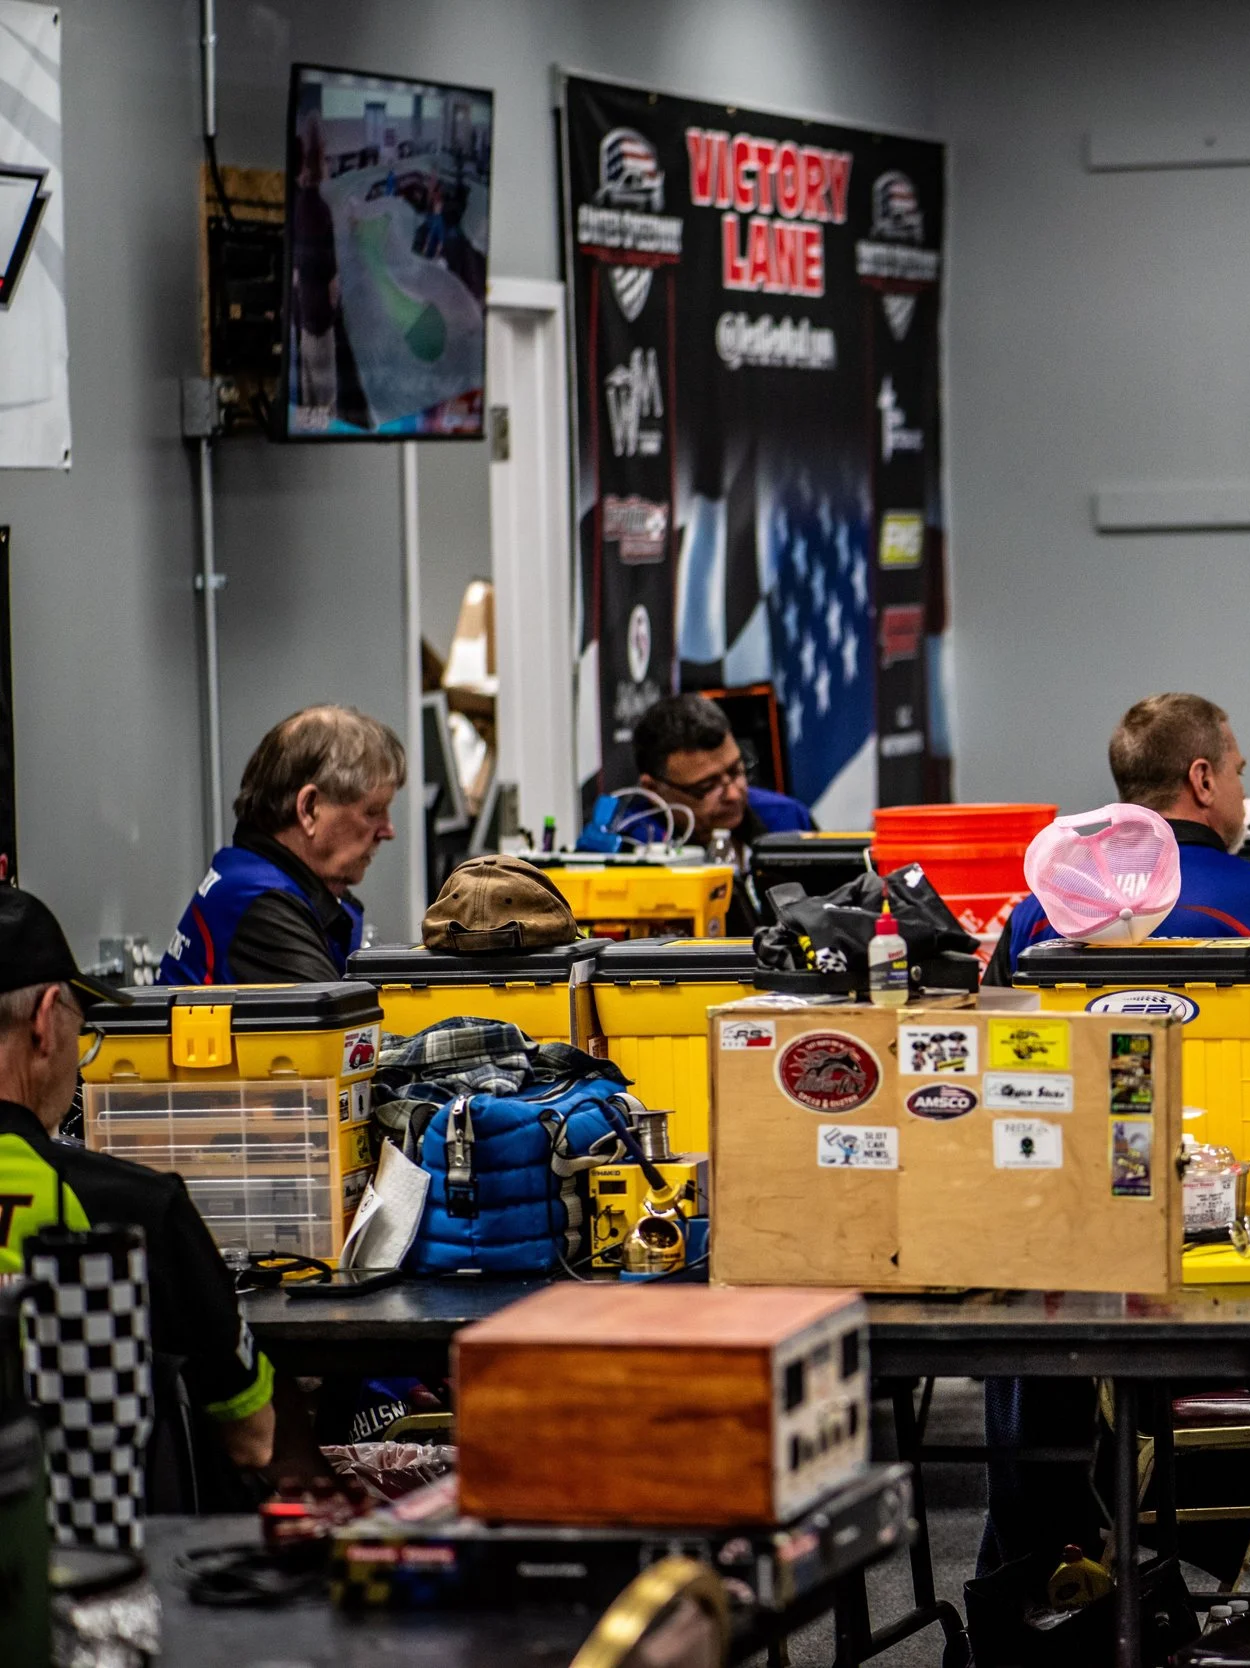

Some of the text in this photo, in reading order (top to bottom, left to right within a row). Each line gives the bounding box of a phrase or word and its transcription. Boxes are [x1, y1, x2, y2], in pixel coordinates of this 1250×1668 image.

[686, 127, 853, 225] VICTORY
[721, 211, 826, 298] LANE
[914, 1096, 970, 1109] AMSCO
